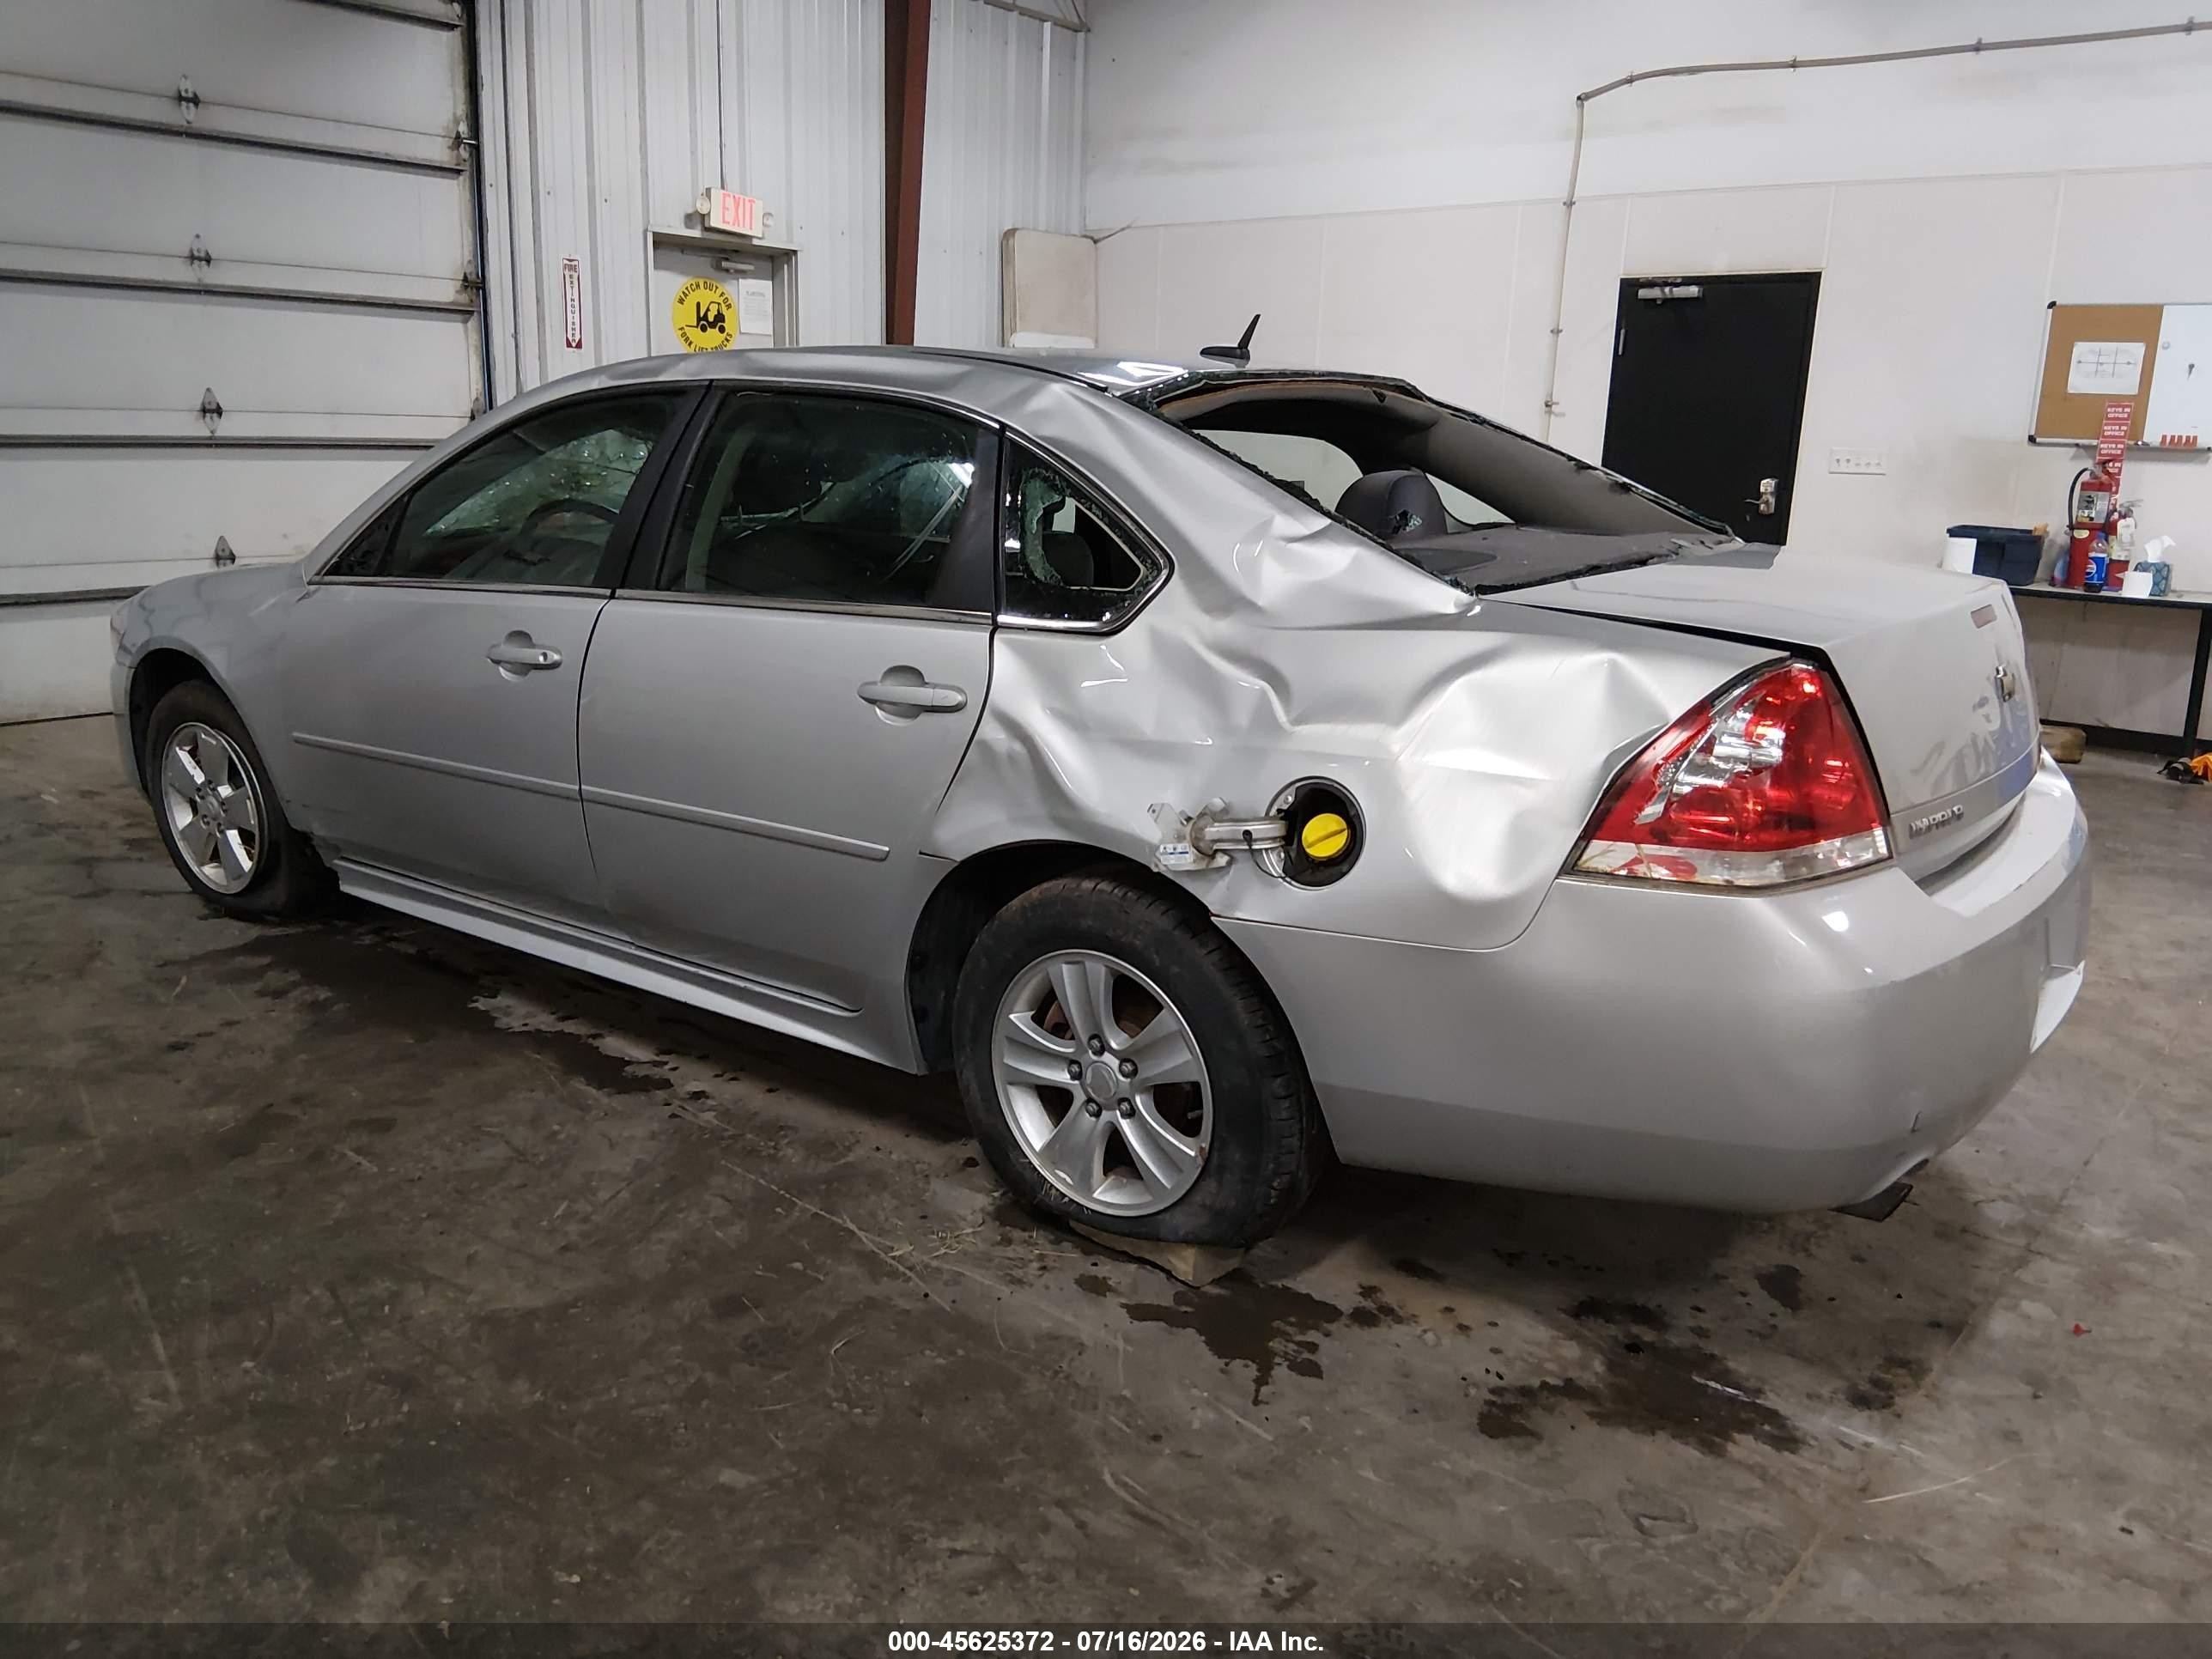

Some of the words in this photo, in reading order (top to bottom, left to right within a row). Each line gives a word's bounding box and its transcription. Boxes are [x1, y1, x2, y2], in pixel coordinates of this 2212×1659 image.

[721, 192, 756, 230] EXIT
[563, 264, 578, 273] FIRE
[677, 282, 702, 306] WATCH
[703, 281, 720, 295] OUT
[718, 291, 732, 311] FOR
[678, 326, 694, 349] FORK
